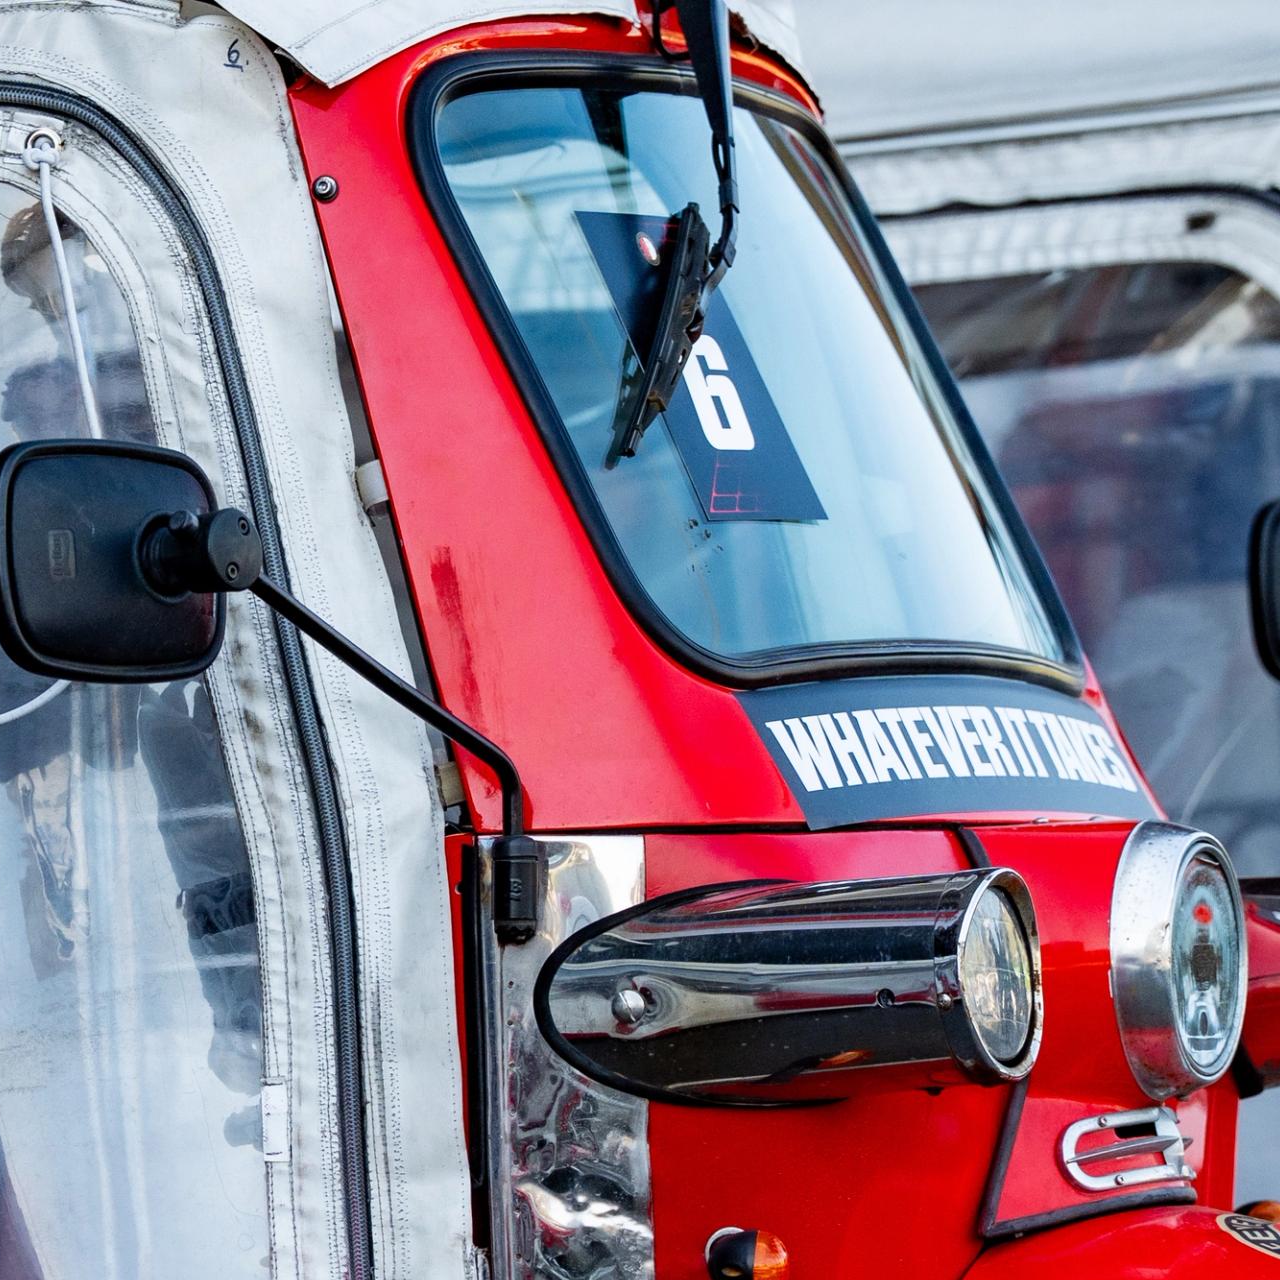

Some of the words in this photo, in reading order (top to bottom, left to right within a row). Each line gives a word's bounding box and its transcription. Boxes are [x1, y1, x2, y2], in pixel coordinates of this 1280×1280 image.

[682, 334, 755, 450] 6
[765, 705, 1020, 792] WHATEVER
[994, 706, 1050, 778] IT
[1024, 709, 1138, 793] TAKES
